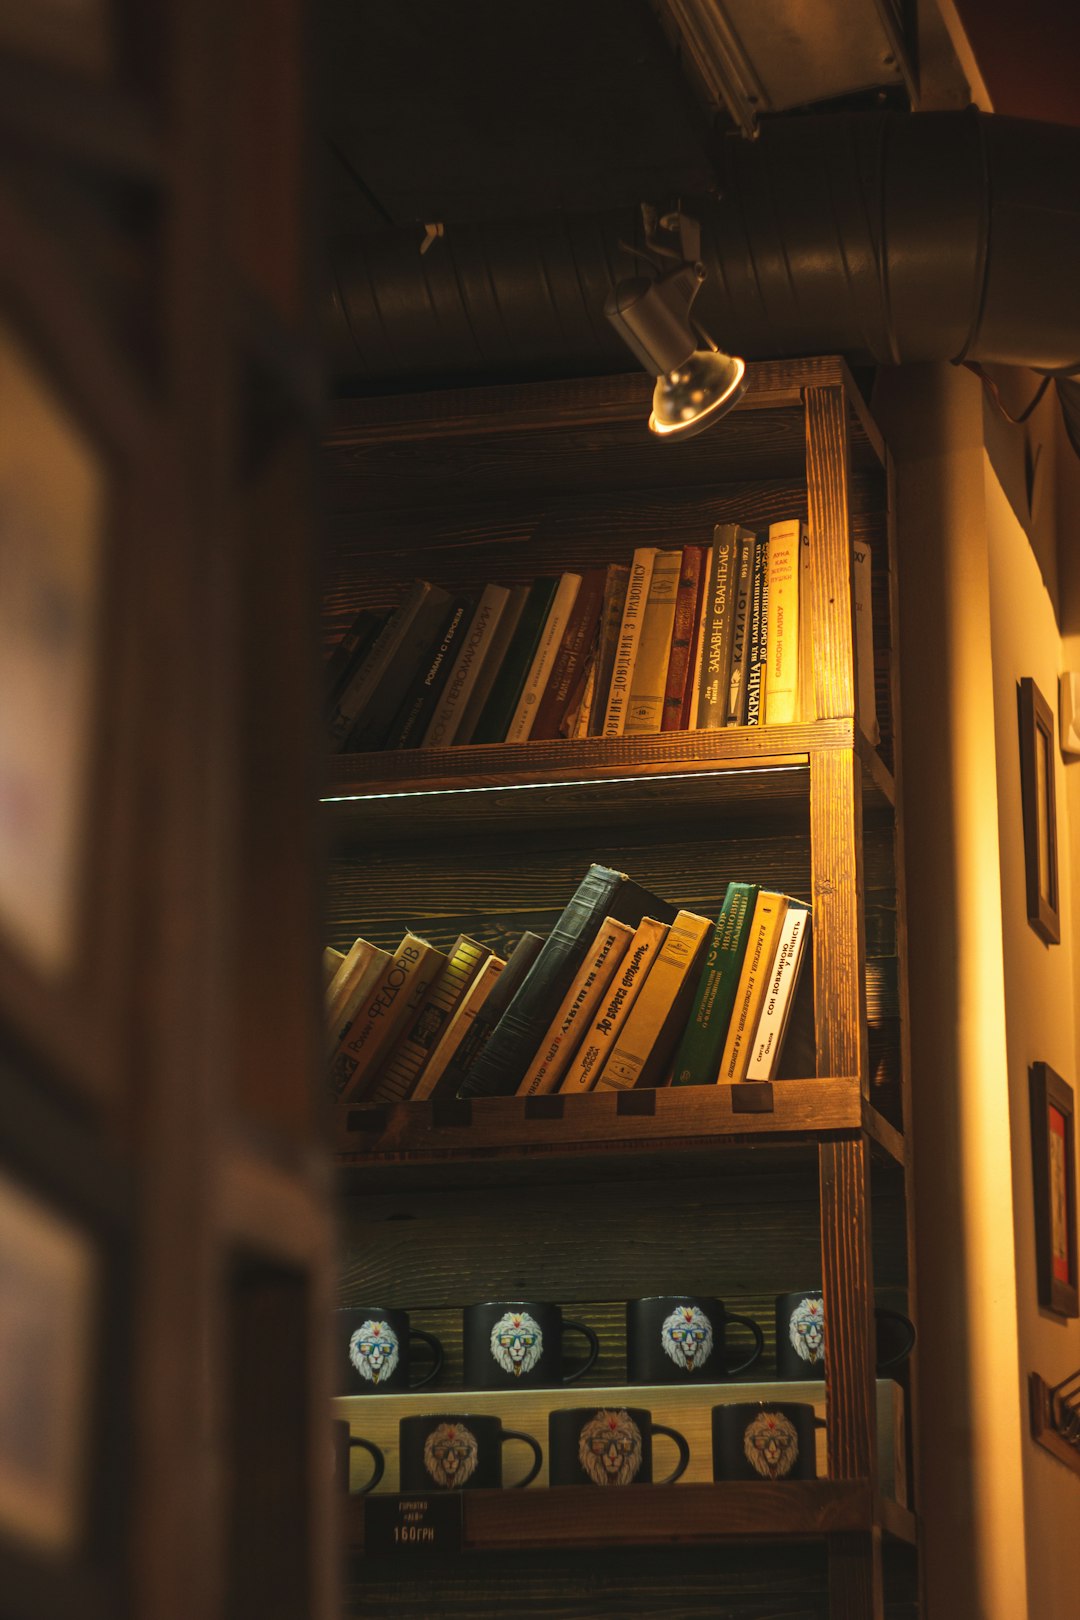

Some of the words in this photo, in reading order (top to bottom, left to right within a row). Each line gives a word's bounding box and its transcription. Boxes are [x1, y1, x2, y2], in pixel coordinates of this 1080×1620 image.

[626, 563, 646, 618] ПРАВОПИСУ
[714, 544, 730, 613] ЄВАНГЕЛІЄ
[424, 653, 444, 686] РОМАН
[440, 644, 448, 652] С
[444, 608, 464, 643] ГЕРОЕМ
[708, 619, 723, 673] ЗАБАВНЕ
[734, 590, 747, 663] КАТАЛОГ
[750, 648, 759, 662] ВІД
[761, 648, 767, 661] ДО
[748, 662, 761, 725] УКРАЇНА
[721, 893, 741, 951] ИВАНОВИЧ
[788, 921, 801, 958] ВІЧНІСТЬ
[595, 935, 616, 968] ТЕРЕН
[707, 951, 718, 966] 2
[368, 947, 420, 1018] ФЕДОРІВ
[584, 972, 597, 988] НА
[767, 997, 775, 1015] СОН
[773, 943, 789, 995] ДОВЖИНОЮ
[561, 990, 587, 1034] ШЛЯХУ
